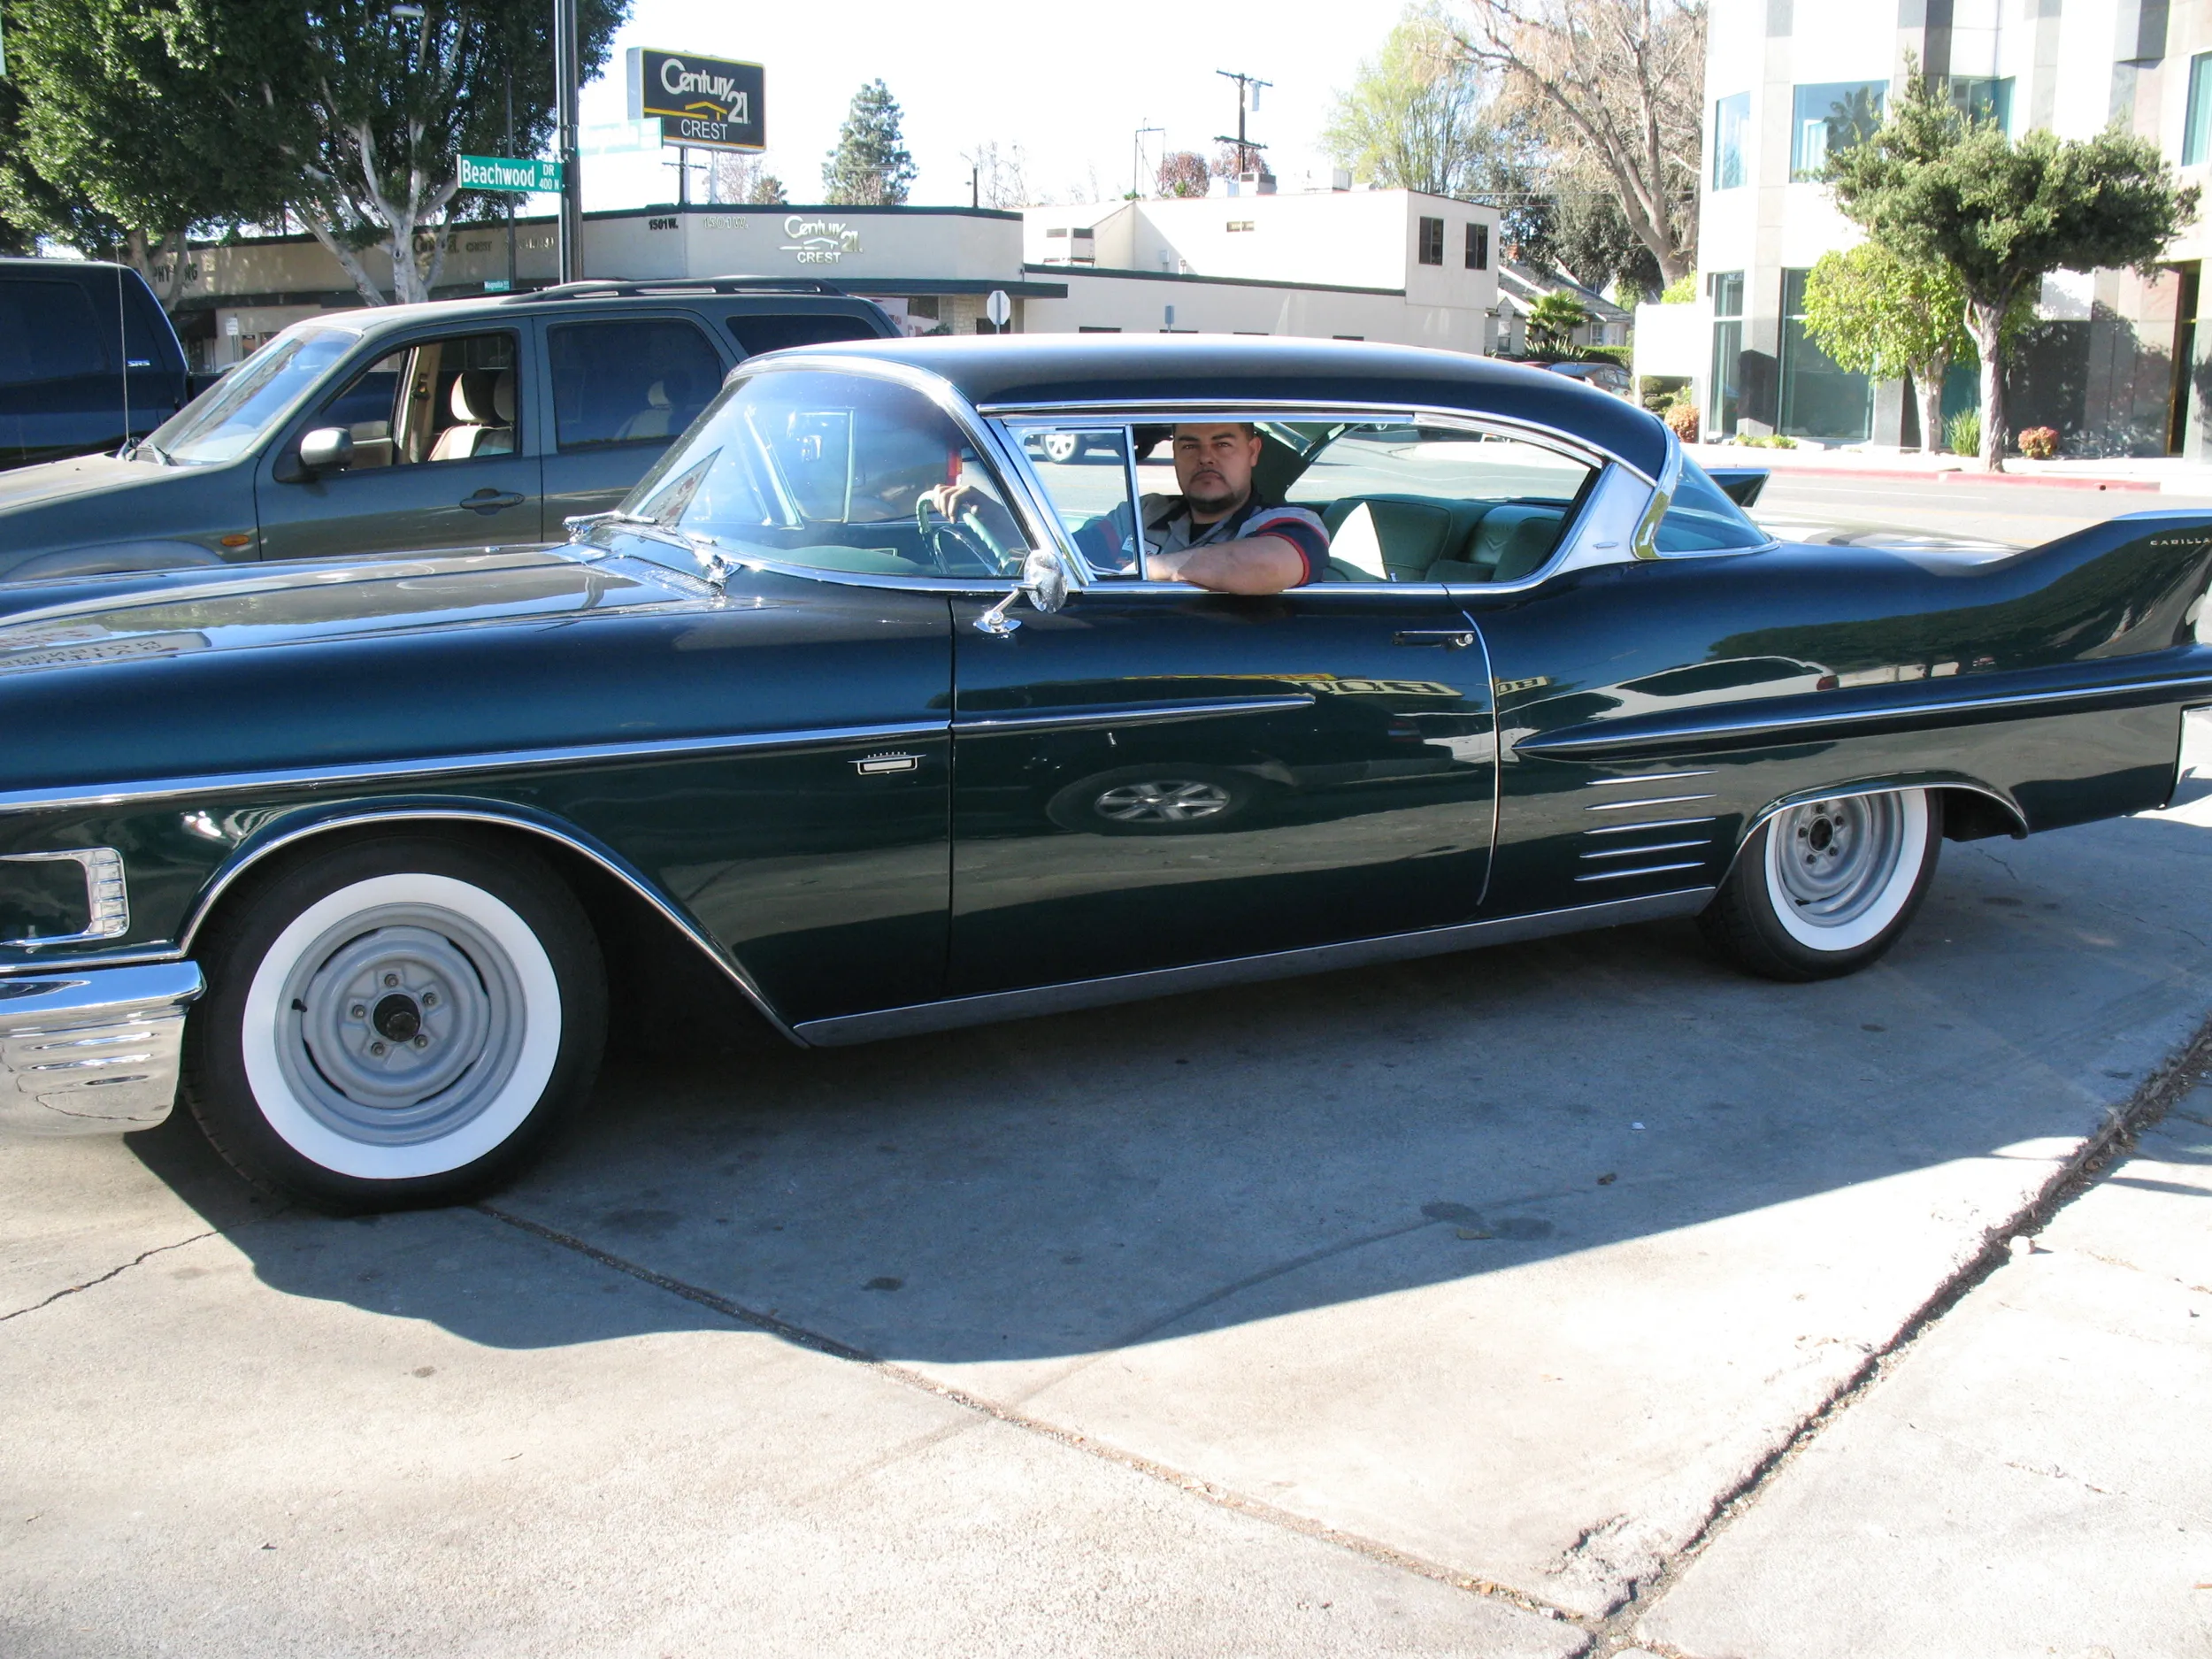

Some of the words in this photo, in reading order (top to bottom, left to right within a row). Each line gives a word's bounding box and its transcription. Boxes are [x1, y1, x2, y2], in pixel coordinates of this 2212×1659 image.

[661, 58, 734, 101] Century
[726, 90, 749, 124] 21
[680, 119, 727, 140] CREST
[462, 159, 535, 188] Beachwood
[542, 164, 555, 176] DR
[539, 178, 552, 190] 400
[554, 179, 560, 190] N
[784, 215, 846, 239] Century
[796, 251, 841, 264] CREST
